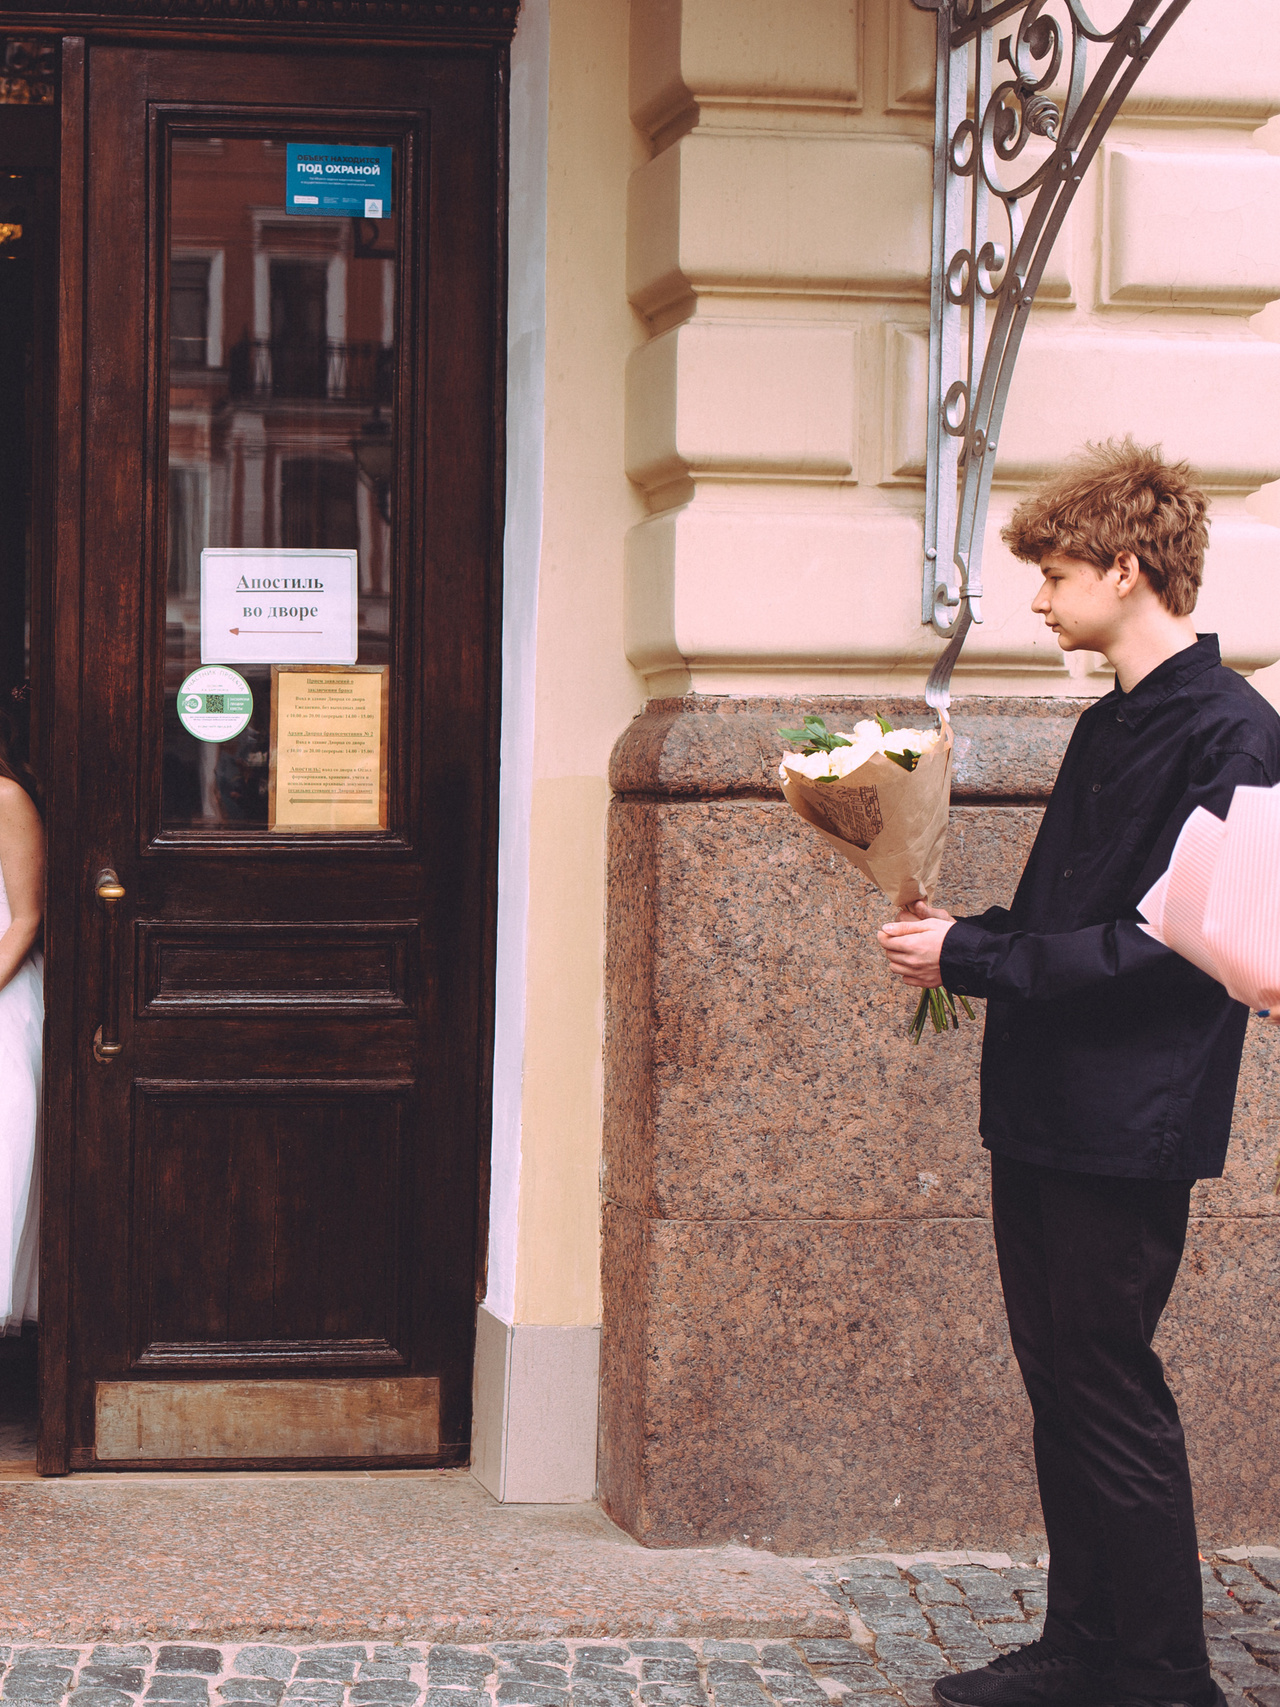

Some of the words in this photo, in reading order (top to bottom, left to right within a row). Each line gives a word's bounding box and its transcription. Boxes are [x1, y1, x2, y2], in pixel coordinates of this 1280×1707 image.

[330, 156, 380, 164] НАХОДИТСЯ
[297, 163, 323, 174] ПОД
[325, 164, 381, 176] ОХРАНОЙ
[236, 574, 324, 590] Апостиль
[242, 606, 263, 618] во
[267, 606, 319, 622] дворе
[186, 669, 216, 692] УЧАСТНИК
[219, 669, 246, 692] ПРОЕКТА
